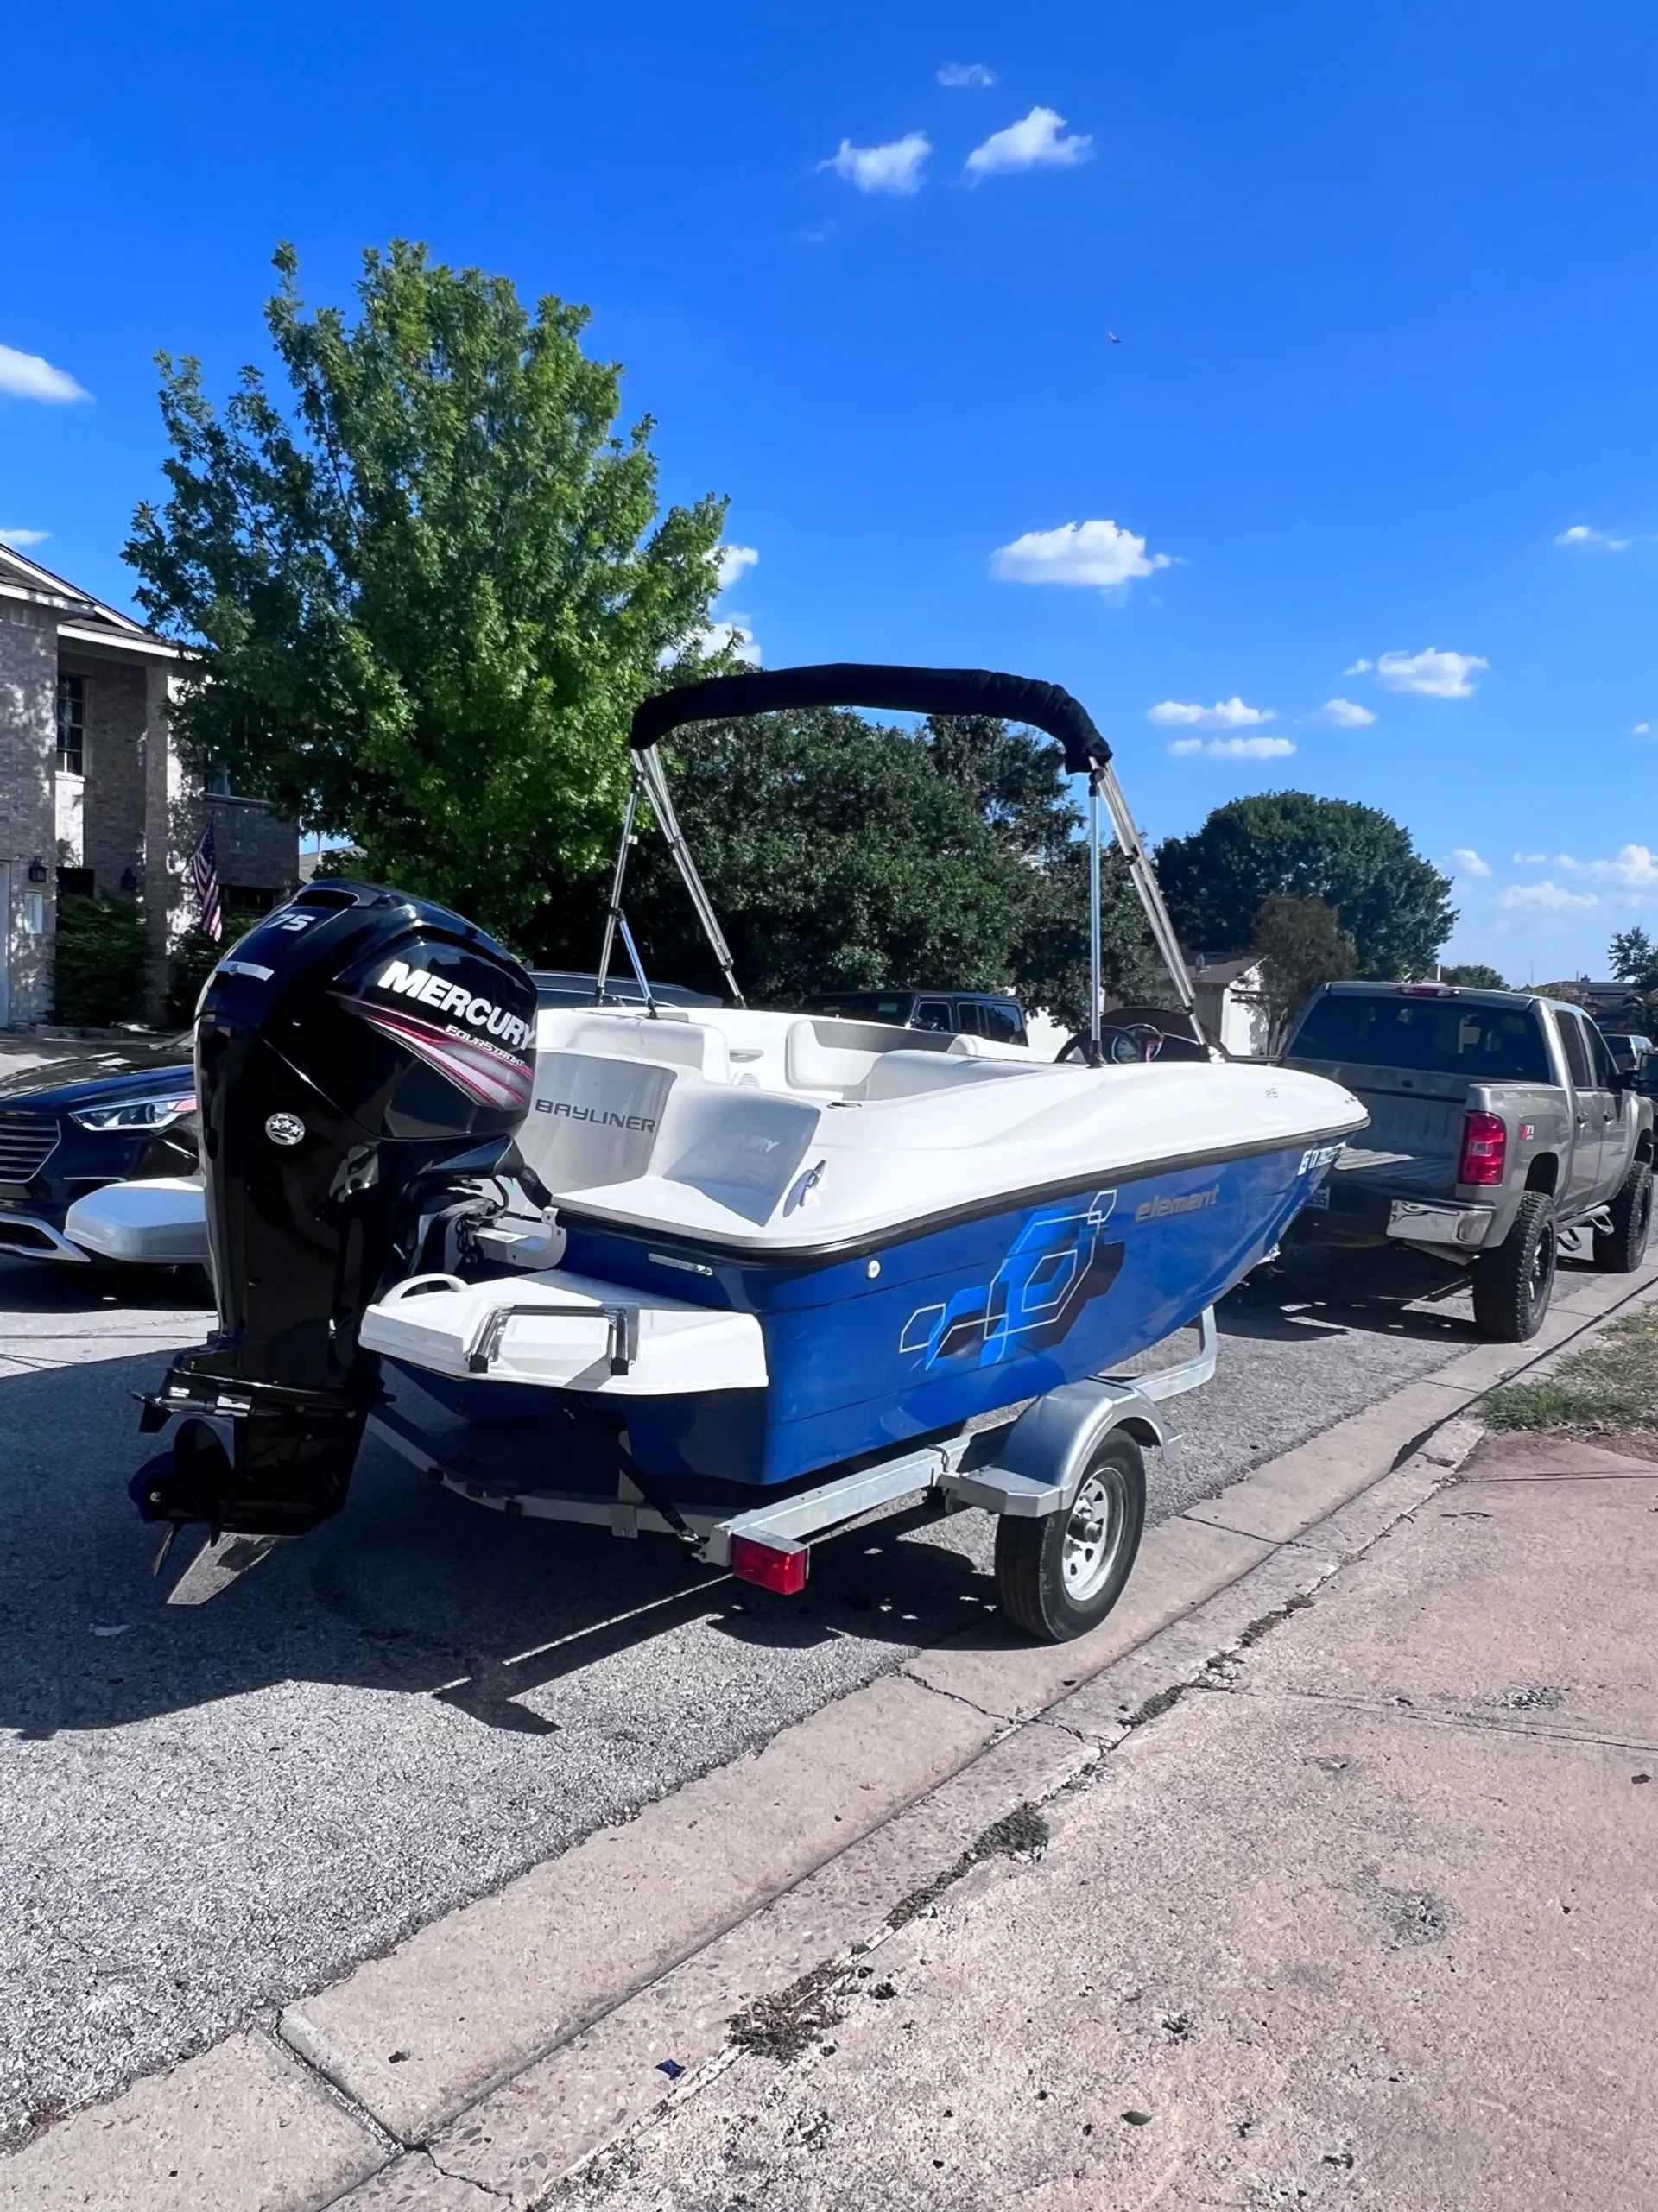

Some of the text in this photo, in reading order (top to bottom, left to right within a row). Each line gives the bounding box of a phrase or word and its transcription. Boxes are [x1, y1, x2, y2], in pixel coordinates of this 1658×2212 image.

[263, 913, 317, 932] 75
[377, 960, 536, 1051] MERCURY
[535, 1098, 657, 1134] BAYLINER
[1135, 1183, 1220, 1222] element
